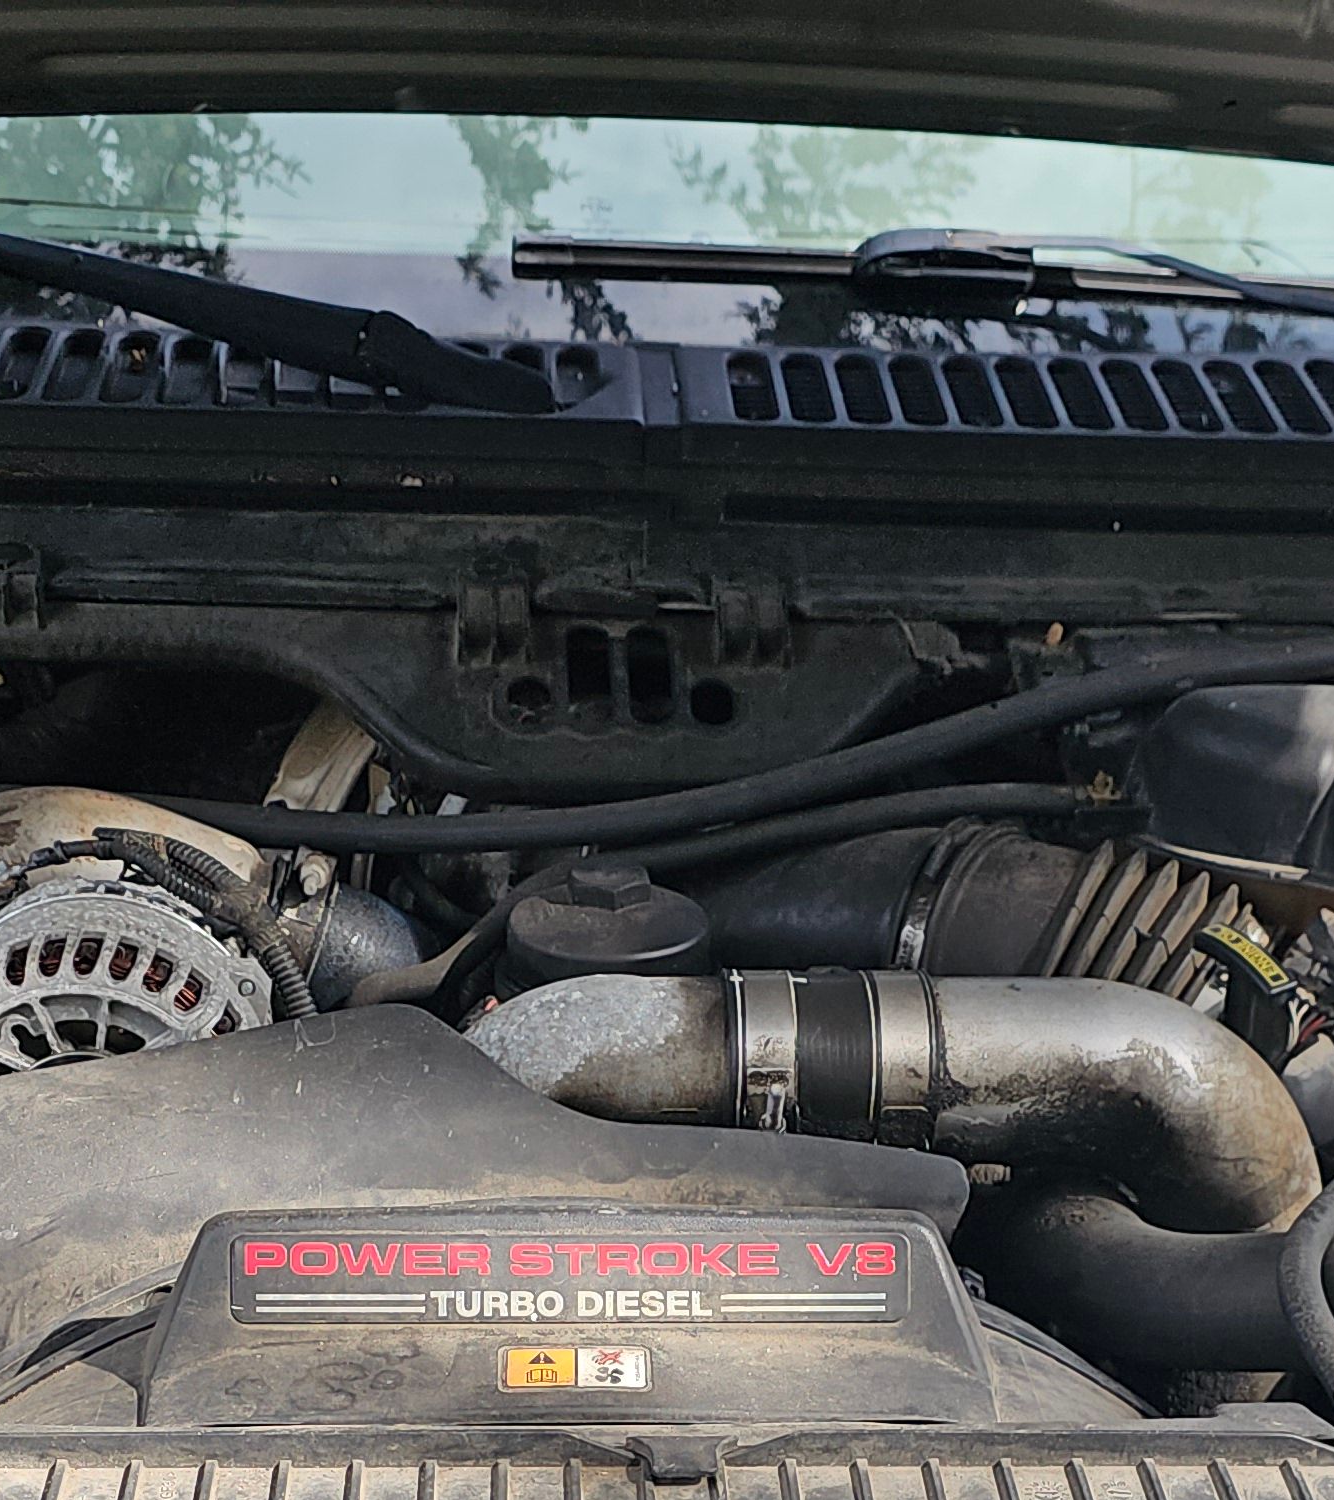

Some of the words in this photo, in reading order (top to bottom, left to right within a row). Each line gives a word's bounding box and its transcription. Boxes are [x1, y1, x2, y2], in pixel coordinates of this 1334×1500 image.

[244, 1241, 492, 1276] POWER
[509, 1241, 780, 1277] STROKE
[806, 1242, 896, 1276] V8
[429, 1289, 565, 1318] TURBO
[577, 1289, 713, 1318] DIESEL
